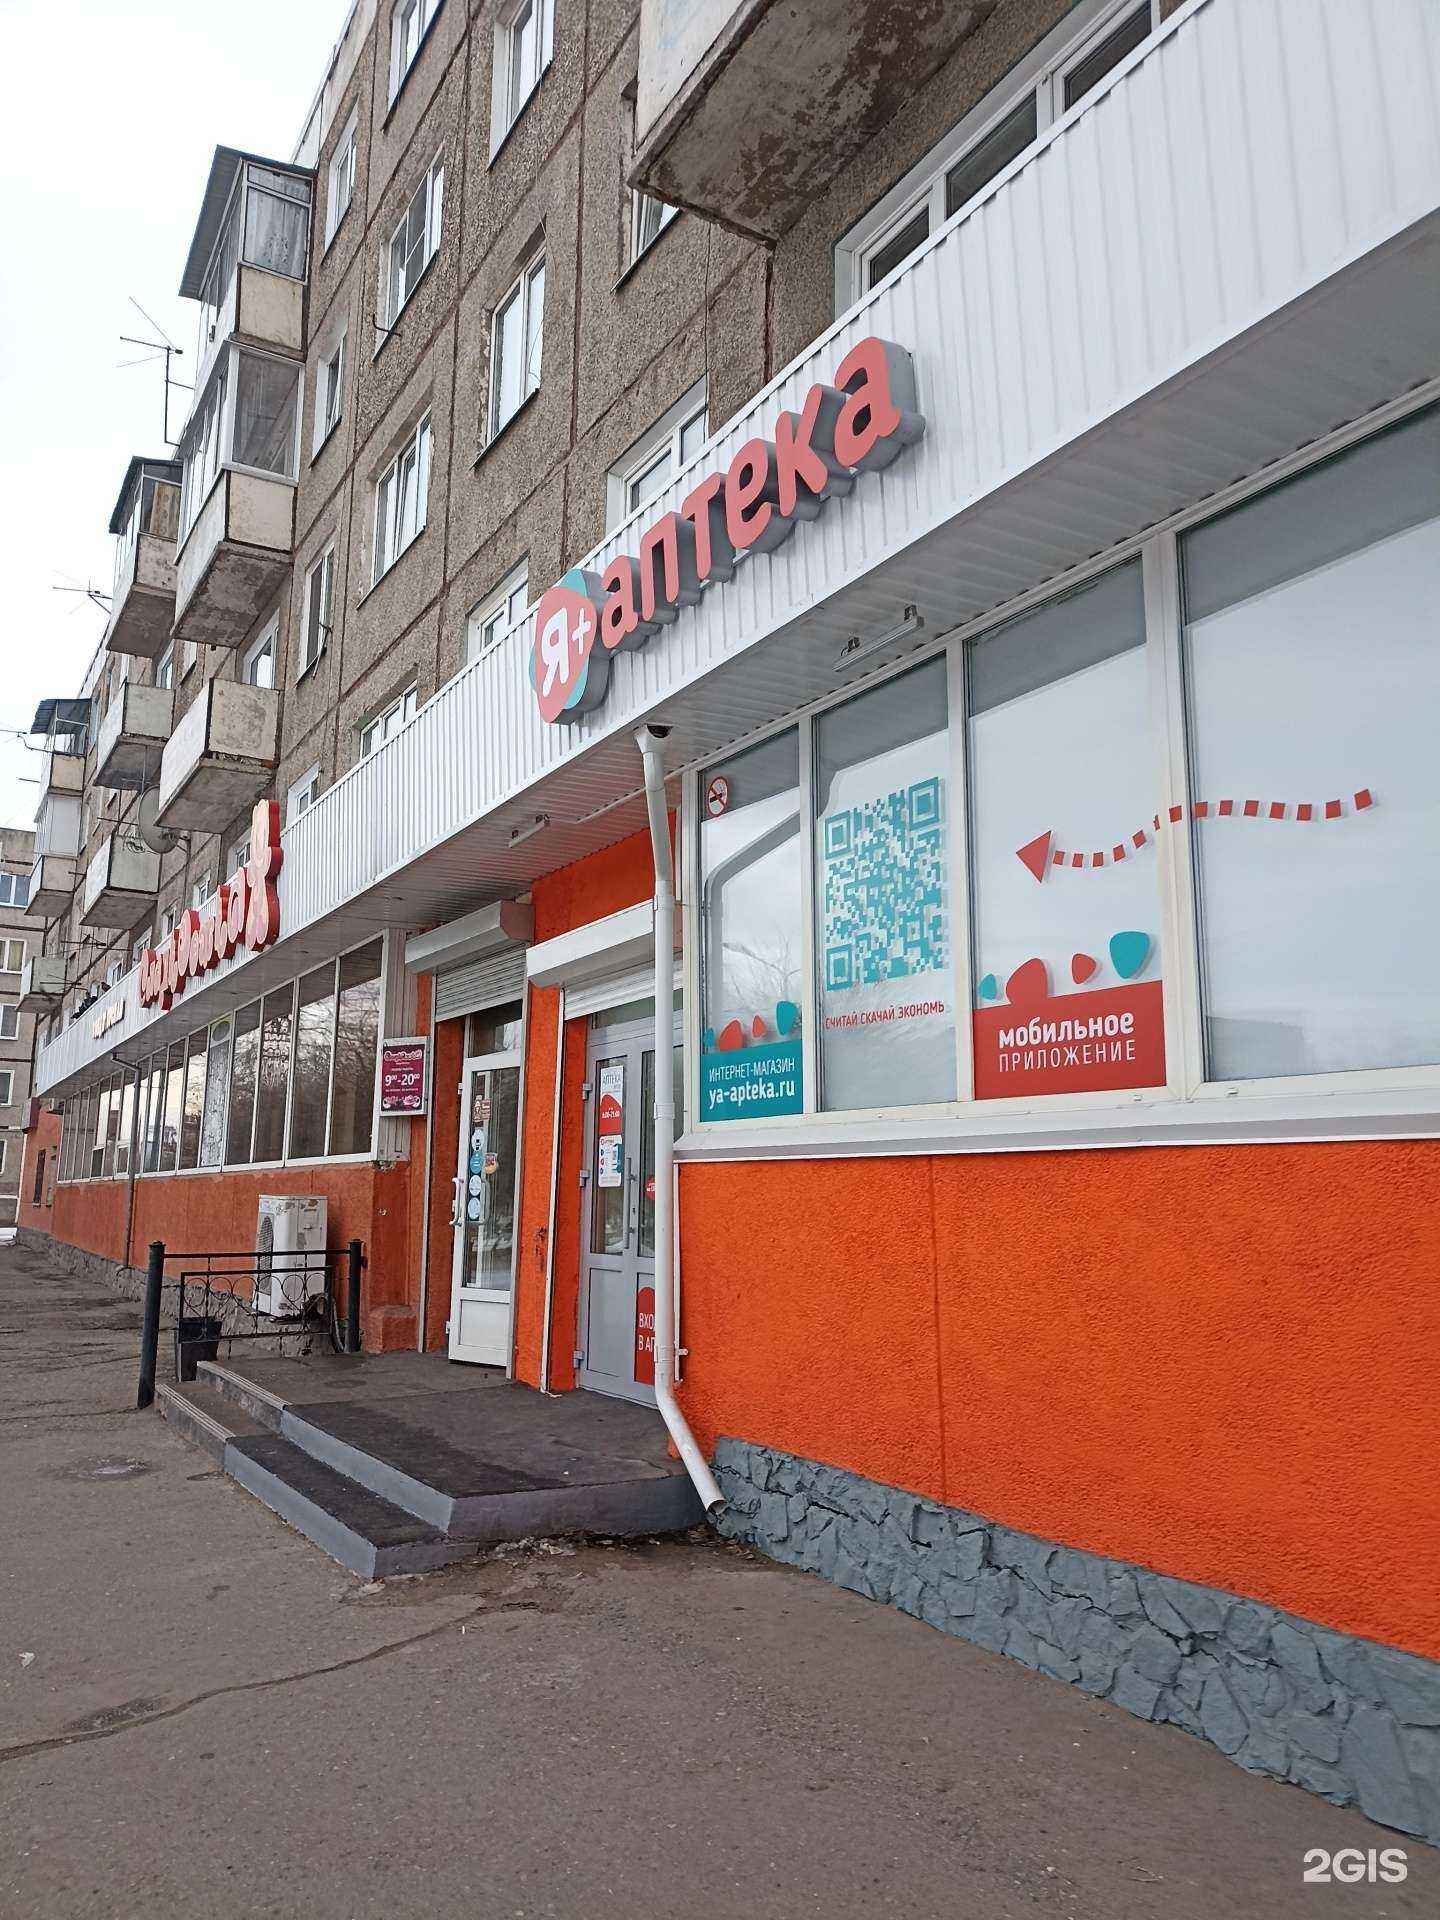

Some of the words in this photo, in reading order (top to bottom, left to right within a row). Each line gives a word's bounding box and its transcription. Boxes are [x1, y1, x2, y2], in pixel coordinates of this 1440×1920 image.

[601, 336, 902, 650] аптека
[825, 1011, 858, 1030] СЧИТАЙ
[860, 1005, 895, 1025] СКАЧАЙ
[898, 1000, 945, 1019] ЭКОНОМЬ
[999, 1012, 1134, 1049] мобильное
[709, 1057, 796, 1083] ИНТЕРНЕТ-МАГАЗИН
[999, 1039, 1136, 1072] ПРИЛОЖЕНИЕ
[709, 1077, 796, 1110] ya-apteka.ru
[639, 1312, 655, 1330] ВХО
[638, 1334, 645, 1351] В
